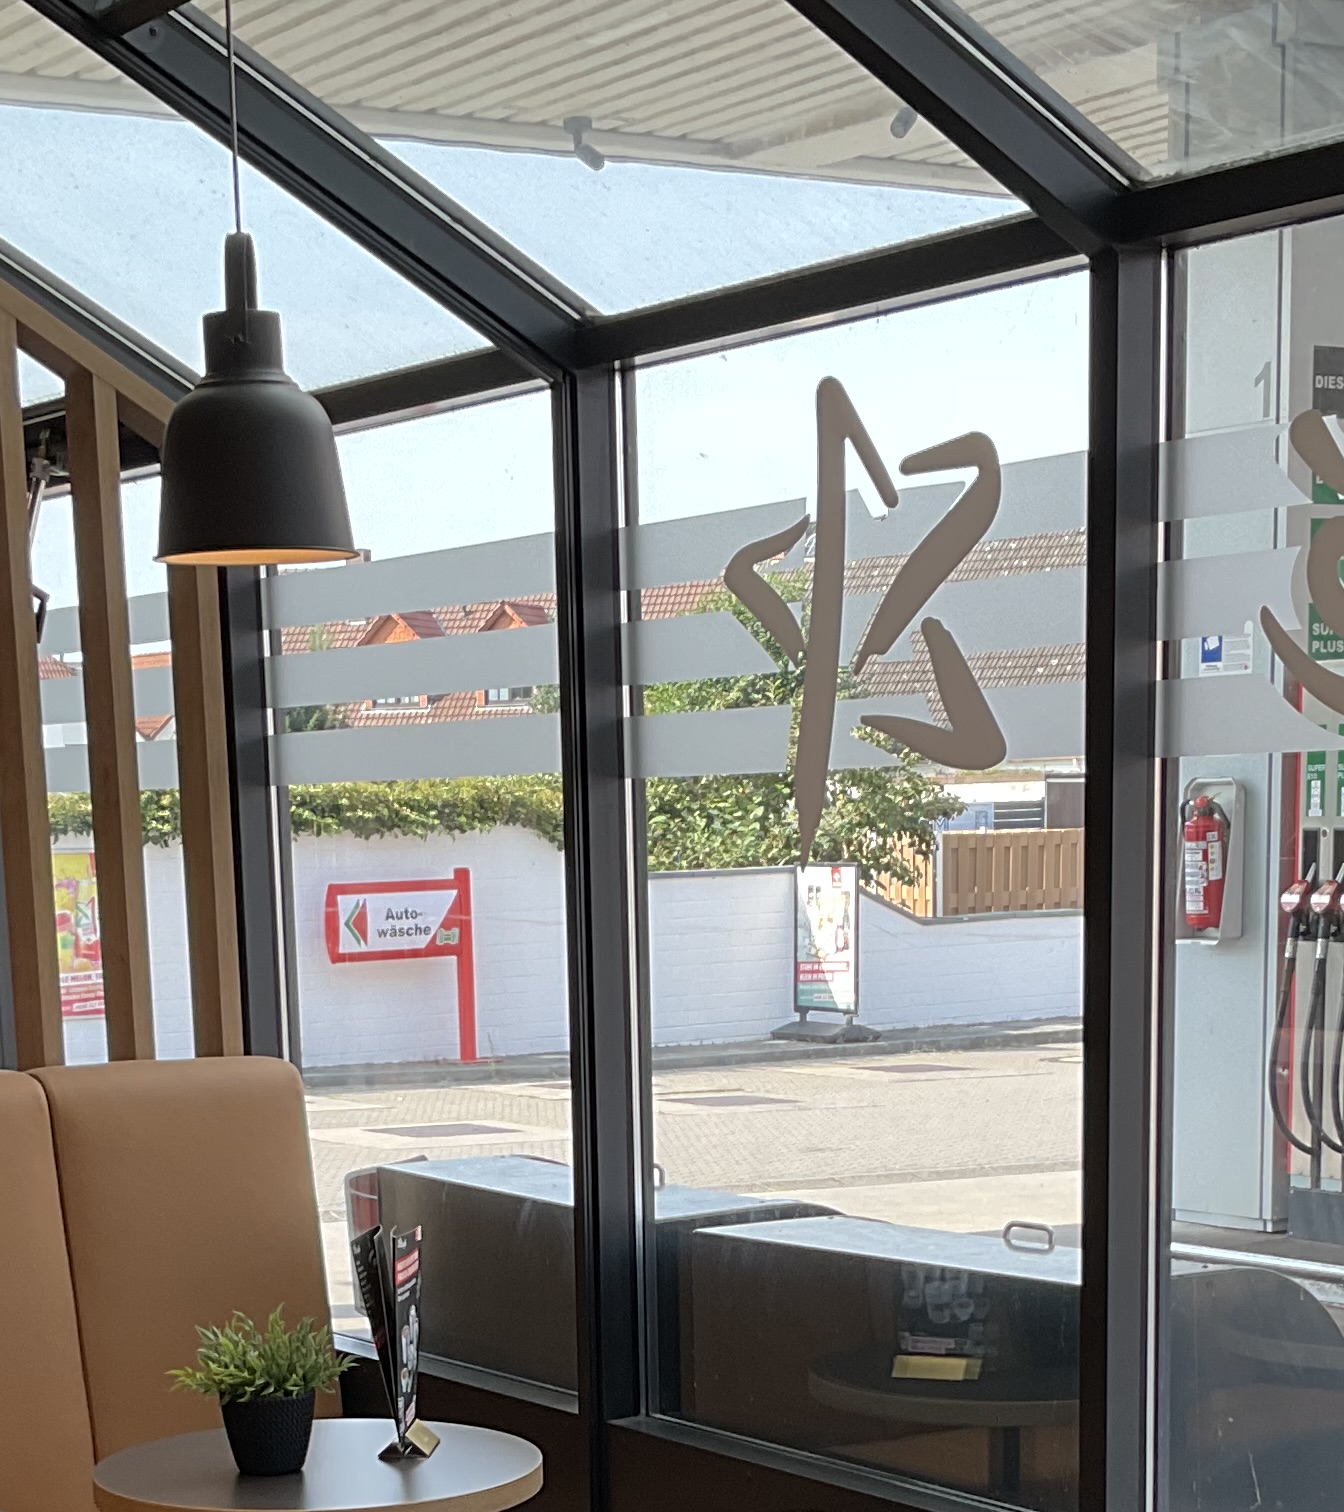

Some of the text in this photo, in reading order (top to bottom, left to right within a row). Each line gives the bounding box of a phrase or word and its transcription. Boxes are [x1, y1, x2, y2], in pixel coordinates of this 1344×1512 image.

[1254, 361, 1272, 418] 1
[1312, 640, 1344, 653] PLUS
[385, 907, 423, 921] Auto-
[376, 923, 432, 938] wäsche
